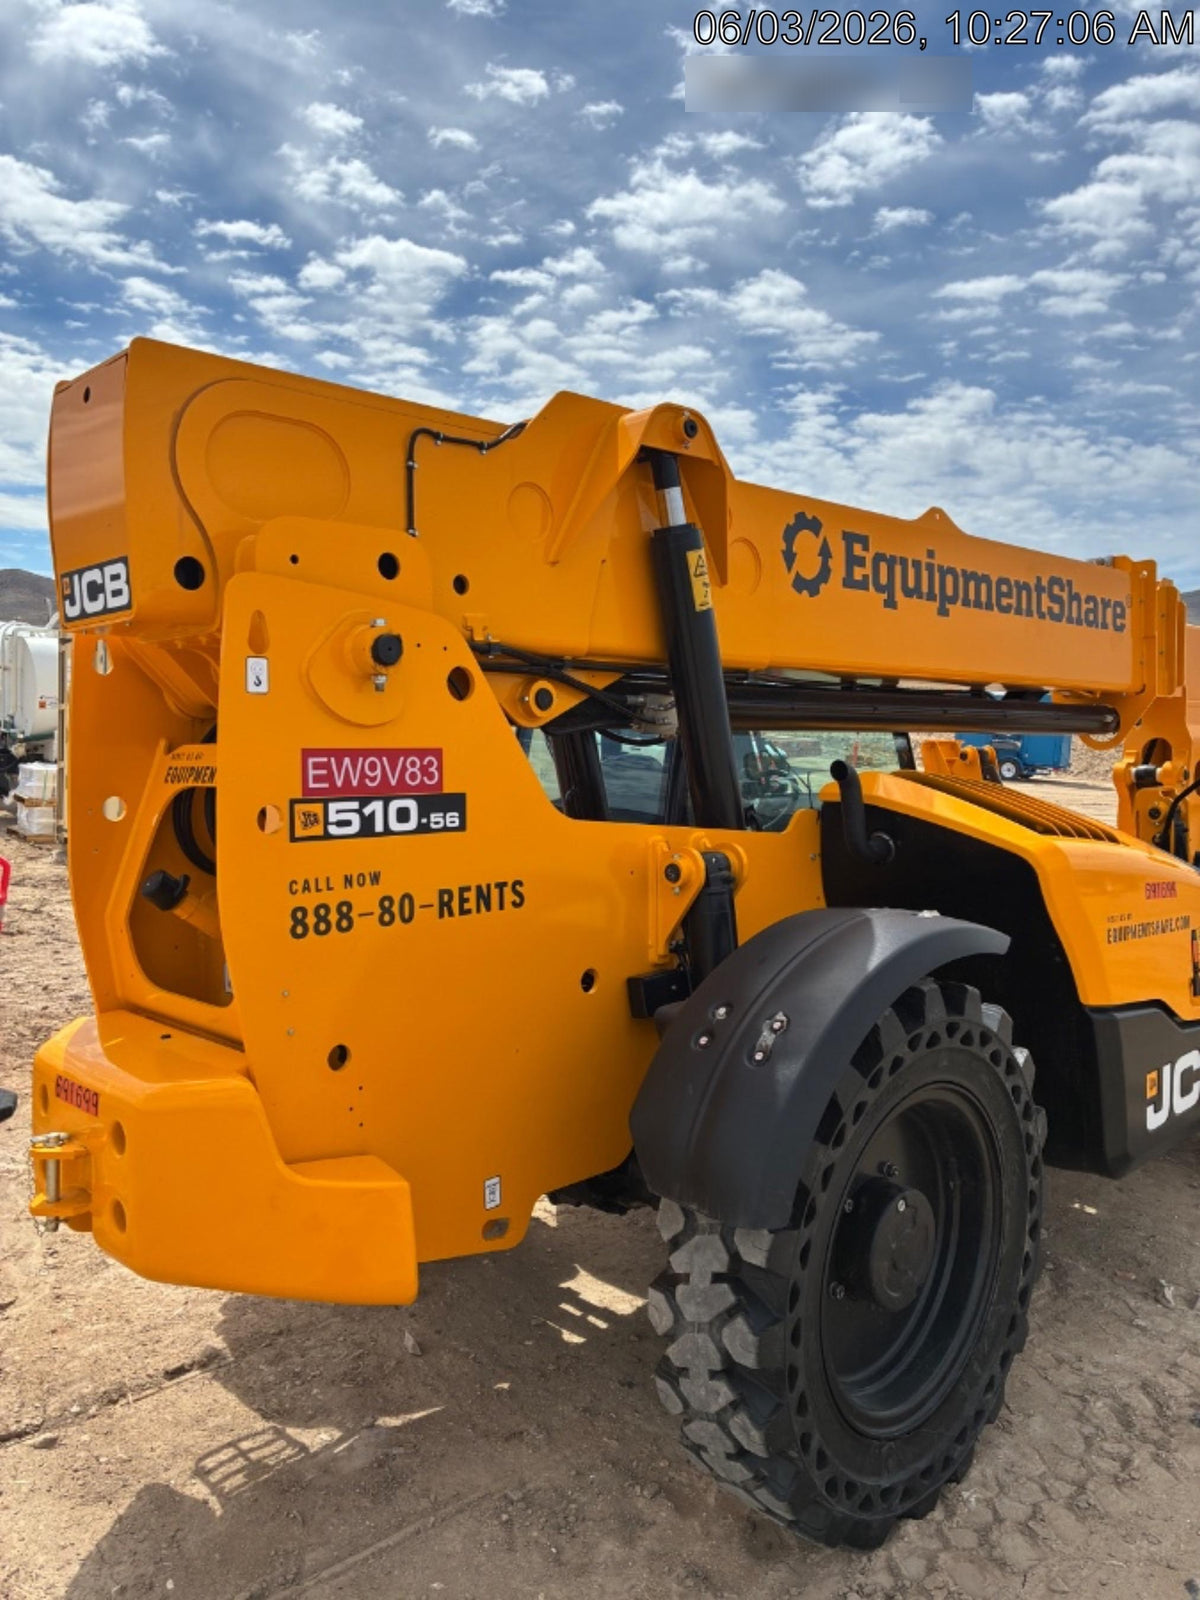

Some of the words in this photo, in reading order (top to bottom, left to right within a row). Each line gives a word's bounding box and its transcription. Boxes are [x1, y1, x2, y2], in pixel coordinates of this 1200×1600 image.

[64, 562, 130, 618] JCB
[842, 530, 1126, 632] EquipmentShare
[307, 756, 439, 789] EW9V83
[289, 876, 334, 895] CALL
[343, 871, 382, 889] NOW
[289, 879, 526, 940] 888-80-RENTS
